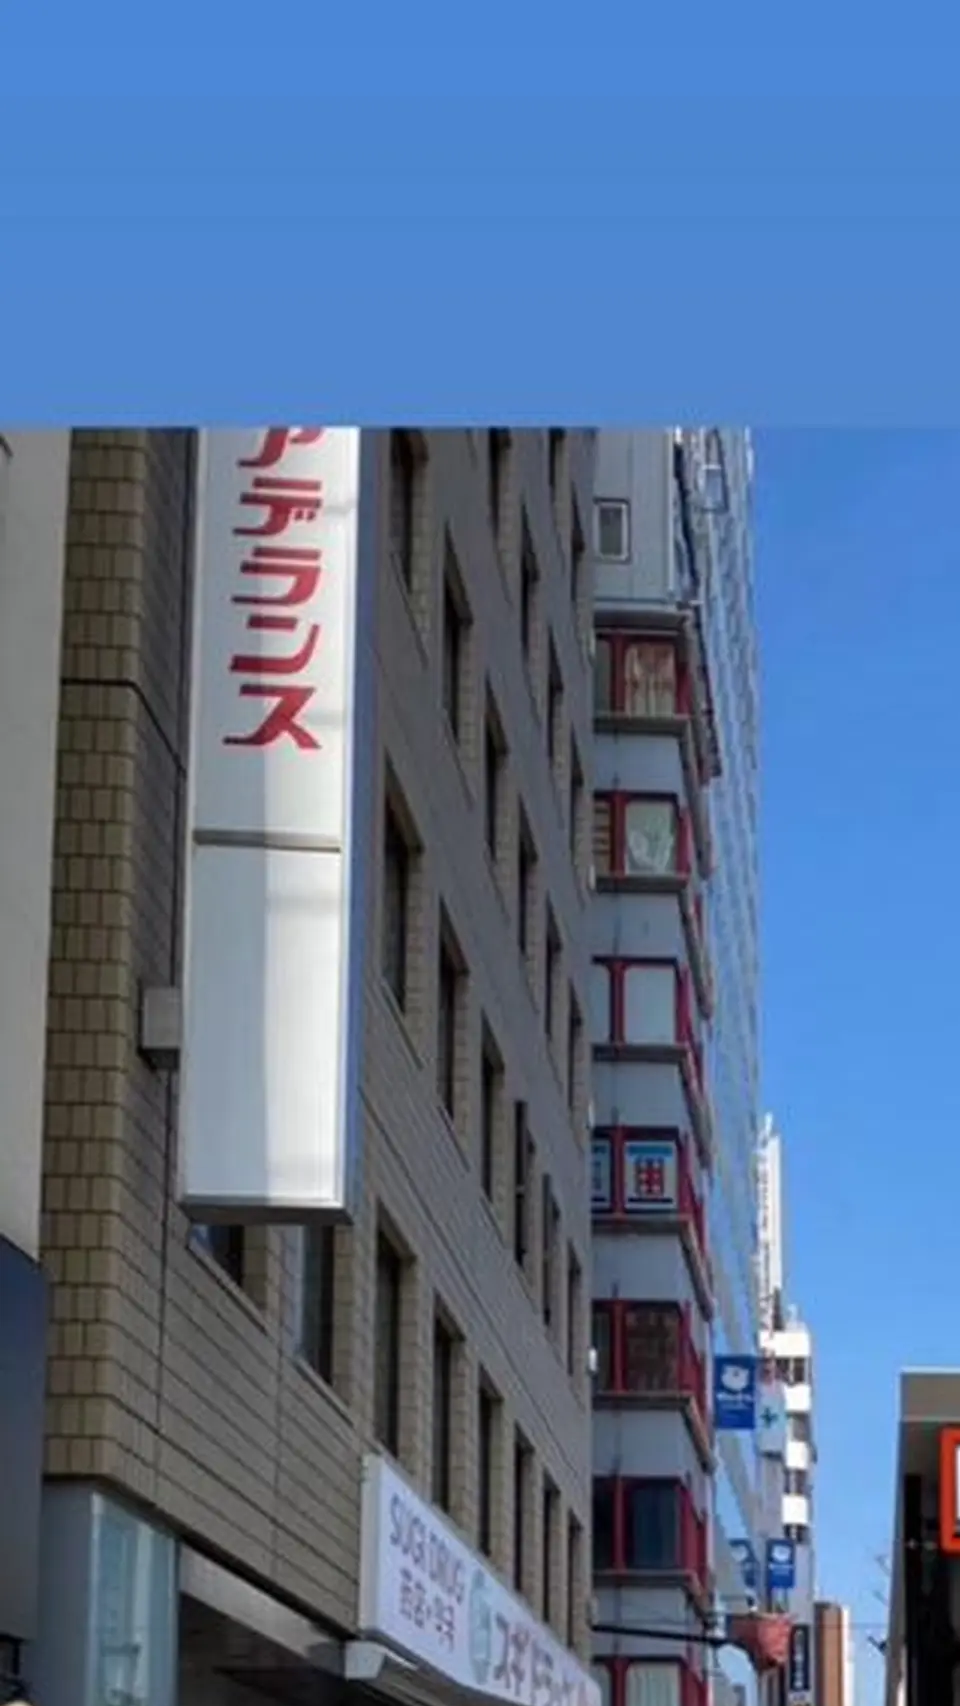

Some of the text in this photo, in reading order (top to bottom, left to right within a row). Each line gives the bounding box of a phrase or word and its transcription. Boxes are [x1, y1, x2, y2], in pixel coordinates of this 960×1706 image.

[222, 427, 322, 750] アデランス
